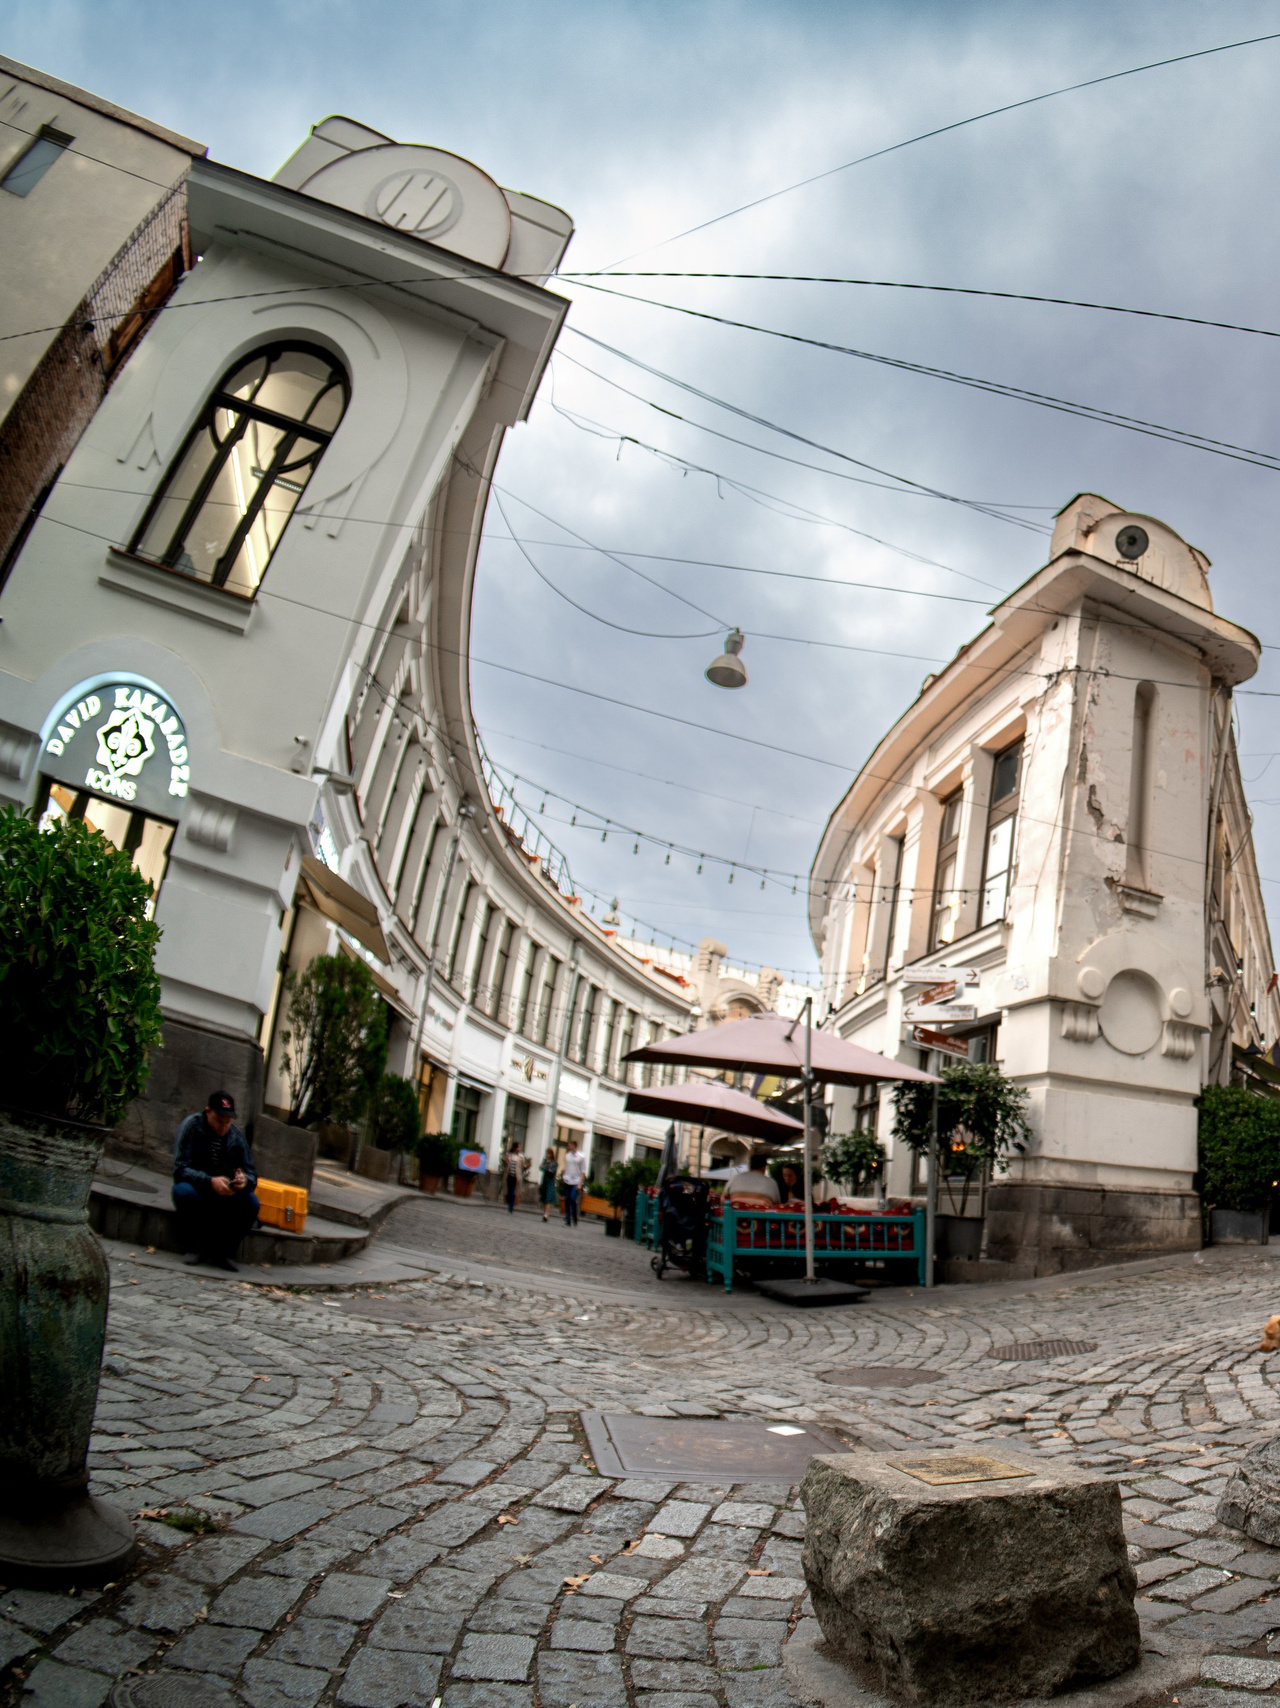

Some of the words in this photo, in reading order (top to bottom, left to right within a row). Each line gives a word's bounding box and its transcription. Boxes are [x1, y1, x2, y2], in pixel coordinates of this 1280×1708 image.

[46, 695, 101, 757] DAVID
[114, 687, 190, 798] KAKABADZE
[84, 767, 137, 801] ICONS
